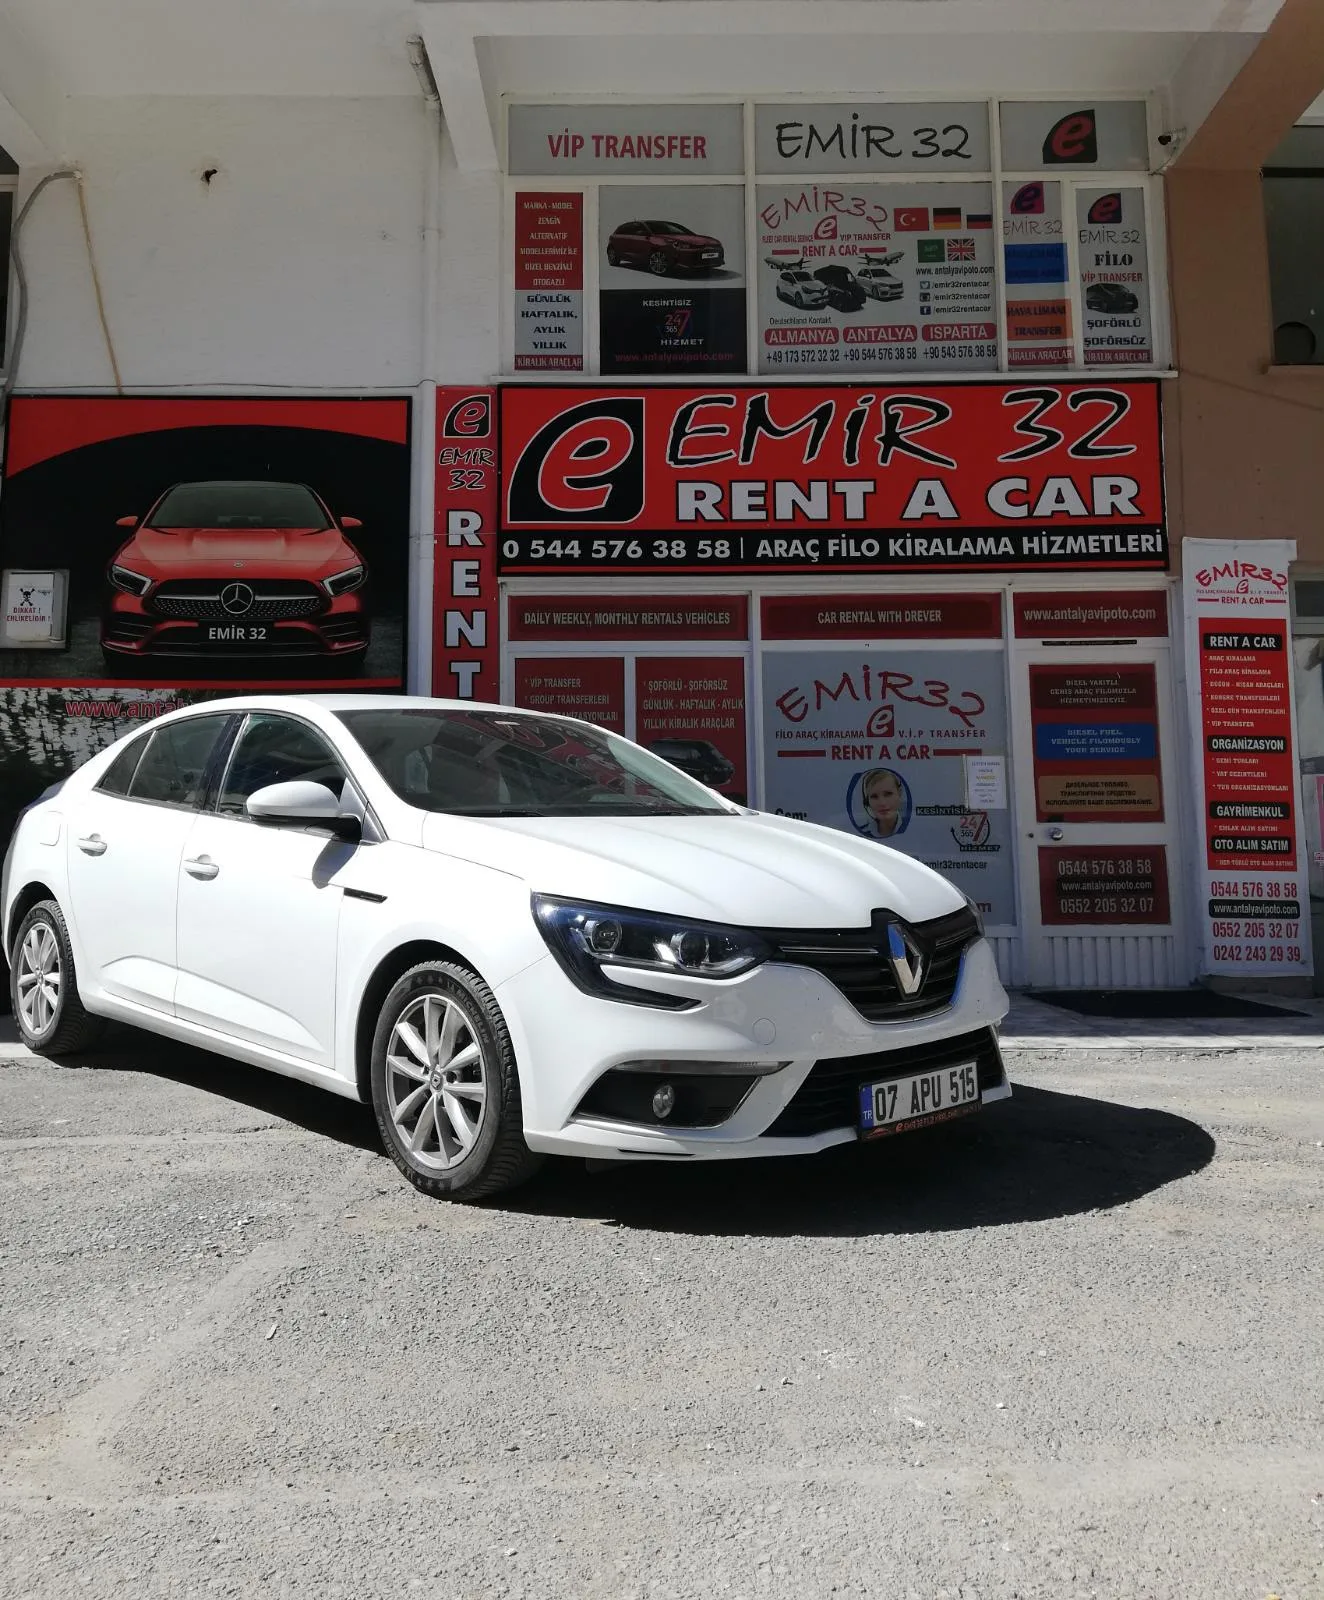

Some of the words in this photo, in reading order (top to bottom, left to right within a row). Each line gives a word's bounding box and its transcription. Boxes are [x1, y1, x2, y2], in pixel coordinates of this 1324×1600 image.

[776, 113, 902, 158] EMİR
[911, 124, 972, 158] 32
[548, 128, 585, 158] VİP
[592, 135, 707, 159] TRANSFER
[1044, 219, 1063, 235] 32
[853, 233, 891, 241] TRANSFER
[1079, 225, 1118, 244] EMİR
[1121, 230, 1142, 244] 32
[802, 246, 826, 257] RENT
[828, 246, 836, 256] A
[839, 245, 858, 256] CAR
[1095, 251, 1133, 267] FİLO
[1081, 272, 1097, 283] VİP
[1099, 273, 1143, 283] TRANSFER
[527, 294, 571, 303] GÜNLÜK
[642, 298, 692, 307] KESİNTİSİZ
[769, 316, 807, 325] Deutschland
[808, 315, 831, 324] Kontakt
[1087, 317, 1141, 329] ŞOFÖRLÜ
[534, 326, 566, 334] AYLIK
[769, 329, 836, 343] ALMANYA
[846, 327, 914, 342] ANTALYA
[929, 325, 988, 340] ISPARTA
[533, 341, 567, 350] YILLIK
[660, 338, 704, 346] HİZMET
[1083, 336, 1146, 347] ŞOFÖRSÜZ
[766, 351, 783, 364] +49
[784, 351, 799, 363] 173
[801, 350, 816, 363] 572
[817, 350, 828, 362] 32
[829, 350, 840, 362] 32
[843, 349, 859, 361] +90
[860, 348, 875, 360] 544
[878, 348, 893, 360] 576
[894, 348, 905, 359] 38
[906, 347, 917, 359] 58
[923, 347, 939, 359] +90
[941, 346, 956, 359] 543
[958, 346, 973, 358] 576
[975, 346, 986, 358] 38
[986, 345, 997, 357] 58
[666, 392, 957, 469] EMİR
[997, 387, 1137, 463] 32
[439, 447, 494, 466] EMİR
[447, 470, 486, 490] 32
[677, 480, 876, 522] RENT
[901, 477, 960, 520] A
[986, 475, 1145, 519] CAR
[503, 540, 519, 558] 0
[530, 540, 581, 558] 544
[591, 540, 643, 558] 576
[653, 540, 687, 558] 38
[696, 539, 731, 558] 58
[756, 539, 820, 562] ARAÇ
[828, 534, 880, 558] FİLO
[889, 532, 1015, 557] KİRALAMA
[1023, 528, 1162, 555] HİZMETLERİ
[1221, 596, 1239, 604] RENT
[1249, 597, 1265, 605] CAR
[552, 612, 592, 628] WEEKLY,
[594, 612, 639, 625] MONTHLY
[641, 612, 683, 625] RENTALS
[818, 612, 837, 623] CAR
[839, 611, 876, 623] RENTAL
[878, 611, 902, 622] WITH
[904, 610, 942, 622] DREVER
[1023, 606, 1157, 623] www.antalyavipoto.com
[208, 625, 246, 640] EMİR
[249, 627, 267, 640] 32
[1210, 636, 1239, 647] RENT
[1241, 637, 1250, 647] A
[1254, 637, 1276, 648] CAR
[544, 678, 582, 688] TRANSFER
[648, 680, 683, 693] ŞOFÖRLÜ
[688, 679, 728, 693] ŞOFÖRSÜZ
[530, 695, 555, 705] GROUP
[643, 697, 674, 710] GÜNLÜK
[679, 697, 715, 709] HAFTALIK
[722, 696, 744, 708] AYLIK
[643, 718, 666, 729] YILLIK
[668, 716, 699, 729] KİRALIK
[700, 717, 735, 731] ARAÇLAR
[775, 728, 794, 739] FİLO
[795, 730, 819, 740] ARAÇ
[820, 728, 865, 739] KİRALAMA
[930, 730, 986, 738] TRANSFER
[1212, 737, 1284, 750] ORGANİZASYON
[831, 745, 874, 760] RENT
[878, 746, 891, 760] A
[896, 745, 930, 760] CAR
[1216, 804, 1284, 817] GAYRİMENKUL
[960, 830, 974, 838] 365
[1214, 839, 1234, 849] OTO
[1235, 840, 1258, 850] ALIM
[1261, 840, 1289, 851] SATIM
[1058, 860, 1088, 876] 0544
[1092, 860, 1115, 874] 576
[1118, 859, 1133, 874] 38
[1137, 859, 1152, 874] 58
[1062, 881, 1152, 893] www.antalyavipoto.com
[1211, 881, 1239, 897] 0544
[1242, 882, 1263, 897] 576
[1266, 882, 1281, 898] 38
[1284, 883, 1298, 898] 58
[1061, 899, 1091, 913] 0552
[1095, 899, 1117, 912] 205
[1121, 898, 1136, 912] 32
[1140, 898, 1154, 912] 07
[1213, 903, 1298, 916] www.antalyavipoto.com
[1212, 922, 1241, 938] 0552
[1244, 922, 1265, 938] 205
[1269, 923, 1282, 938] 32
[1286, 923, 1299, 938] 07
[1213, 945, 1242, 961] 0242
[1245, 946, 1266, 961] 243
[1270, 946, 1284, 962] 29
[1287, 946, 1301, 962] 39
[874, 1084, 898, 1121] 07
[911, 1074, 942, 1114] APU
[950, 1066, 976, 1103] 515
[863, 1110, 873, 1120] TR
